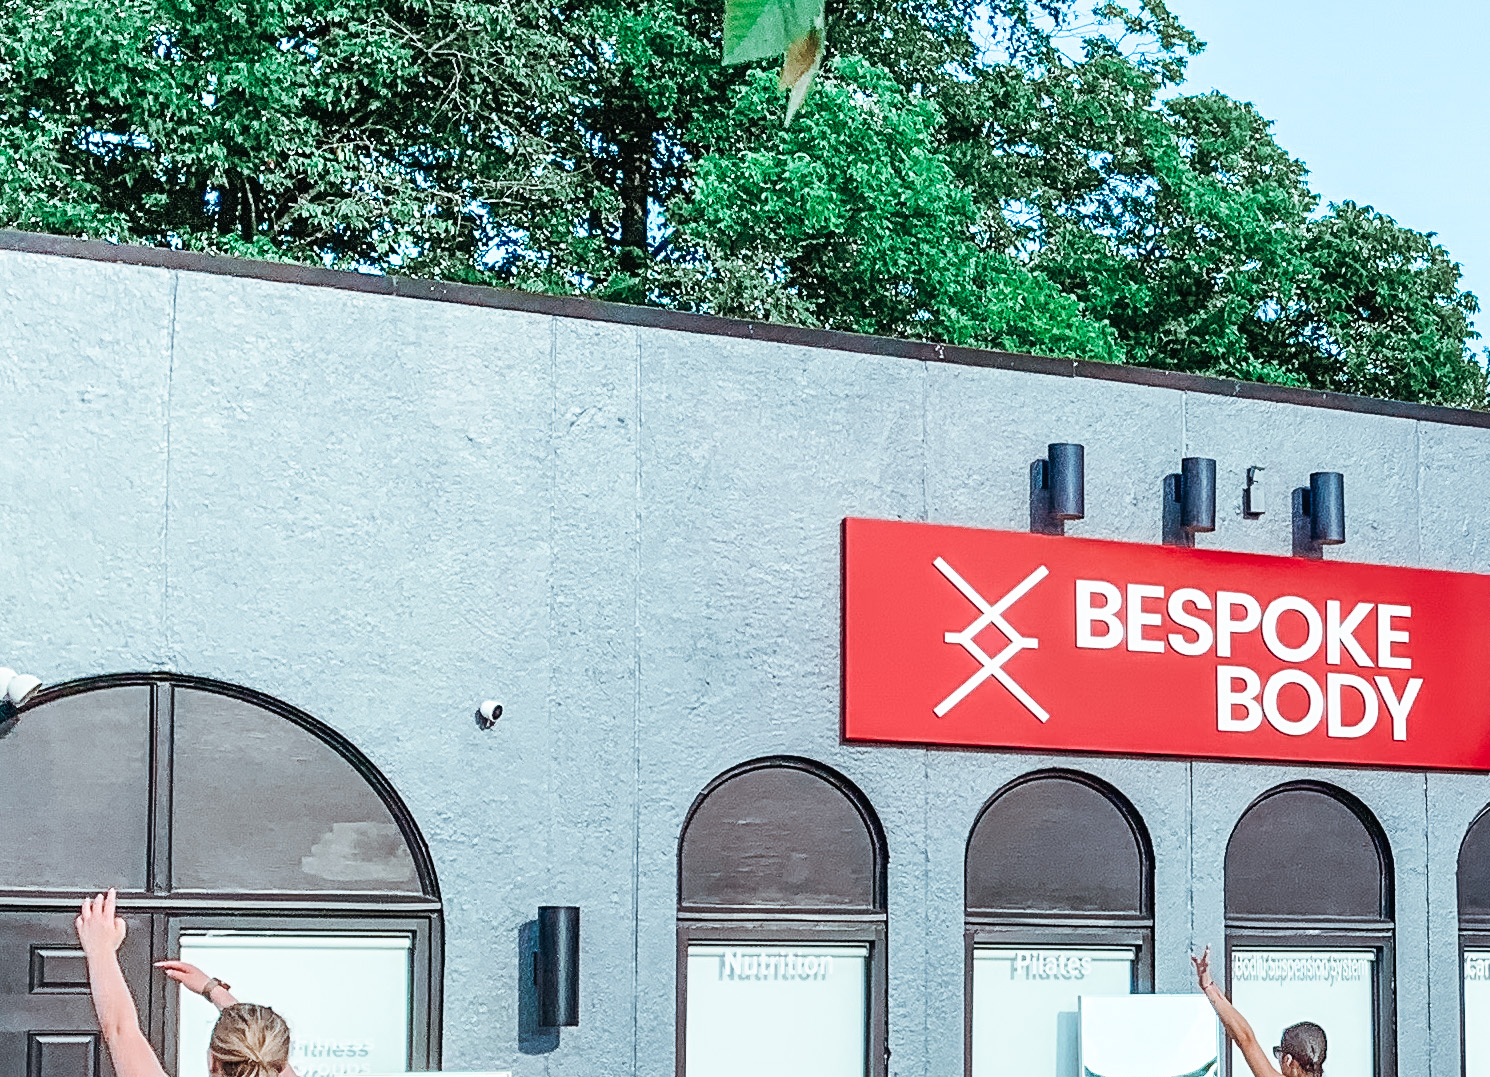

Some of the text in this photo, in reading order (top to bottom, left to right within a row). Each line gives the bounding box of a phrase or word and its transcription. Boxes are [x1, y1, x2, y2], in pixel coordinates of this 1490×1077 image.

[1074, 579, 1413, 670] BESPOKE
[1216, 665, 1424, 741] BODY
[725, 950, 834, 976] Nutrition
[1016, 951, 1092, 976] Pilates
[1267, 953, 1328, 981] Suspension
[1330, 953, 1370, 982] System
